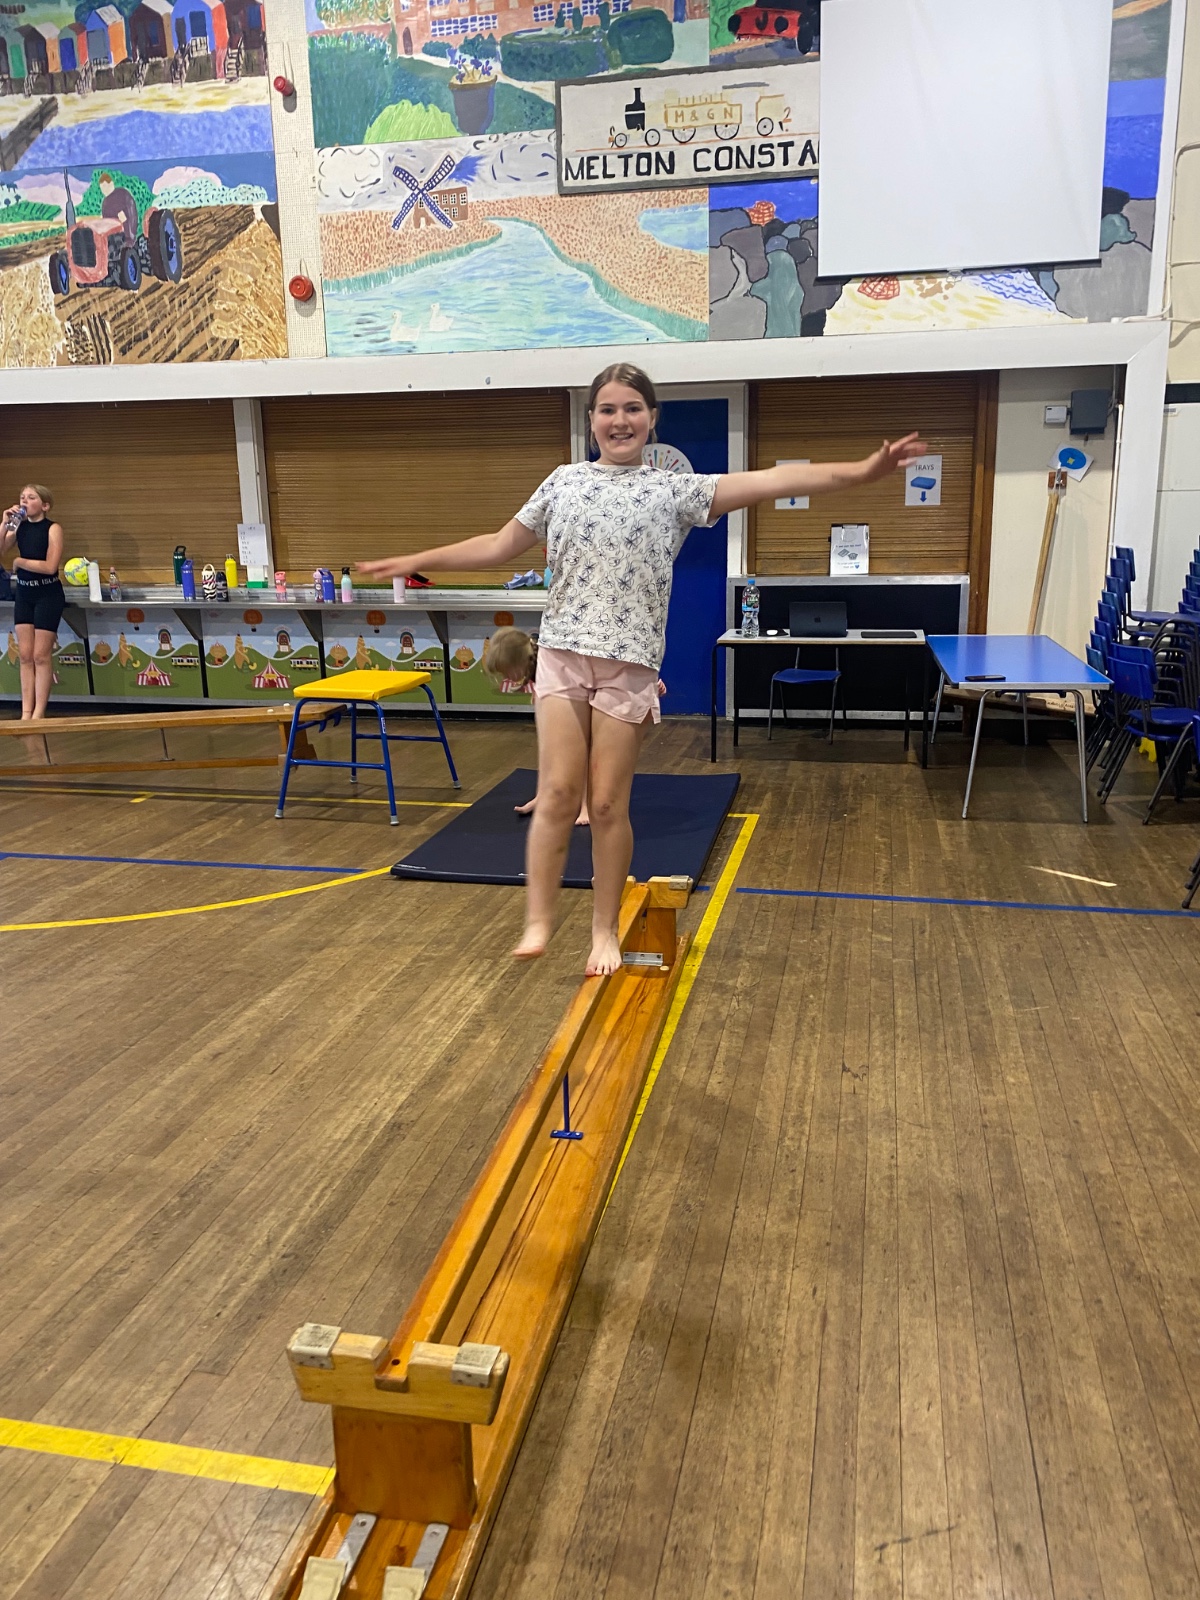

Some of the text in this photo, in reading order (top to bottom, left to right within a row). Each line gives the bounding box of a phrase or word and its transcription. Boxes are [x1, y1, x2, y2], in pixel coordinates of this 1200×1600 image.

[674, 106, 733, 123] M & G N
[564, 138, 820, 181] MELTON CONSTA
